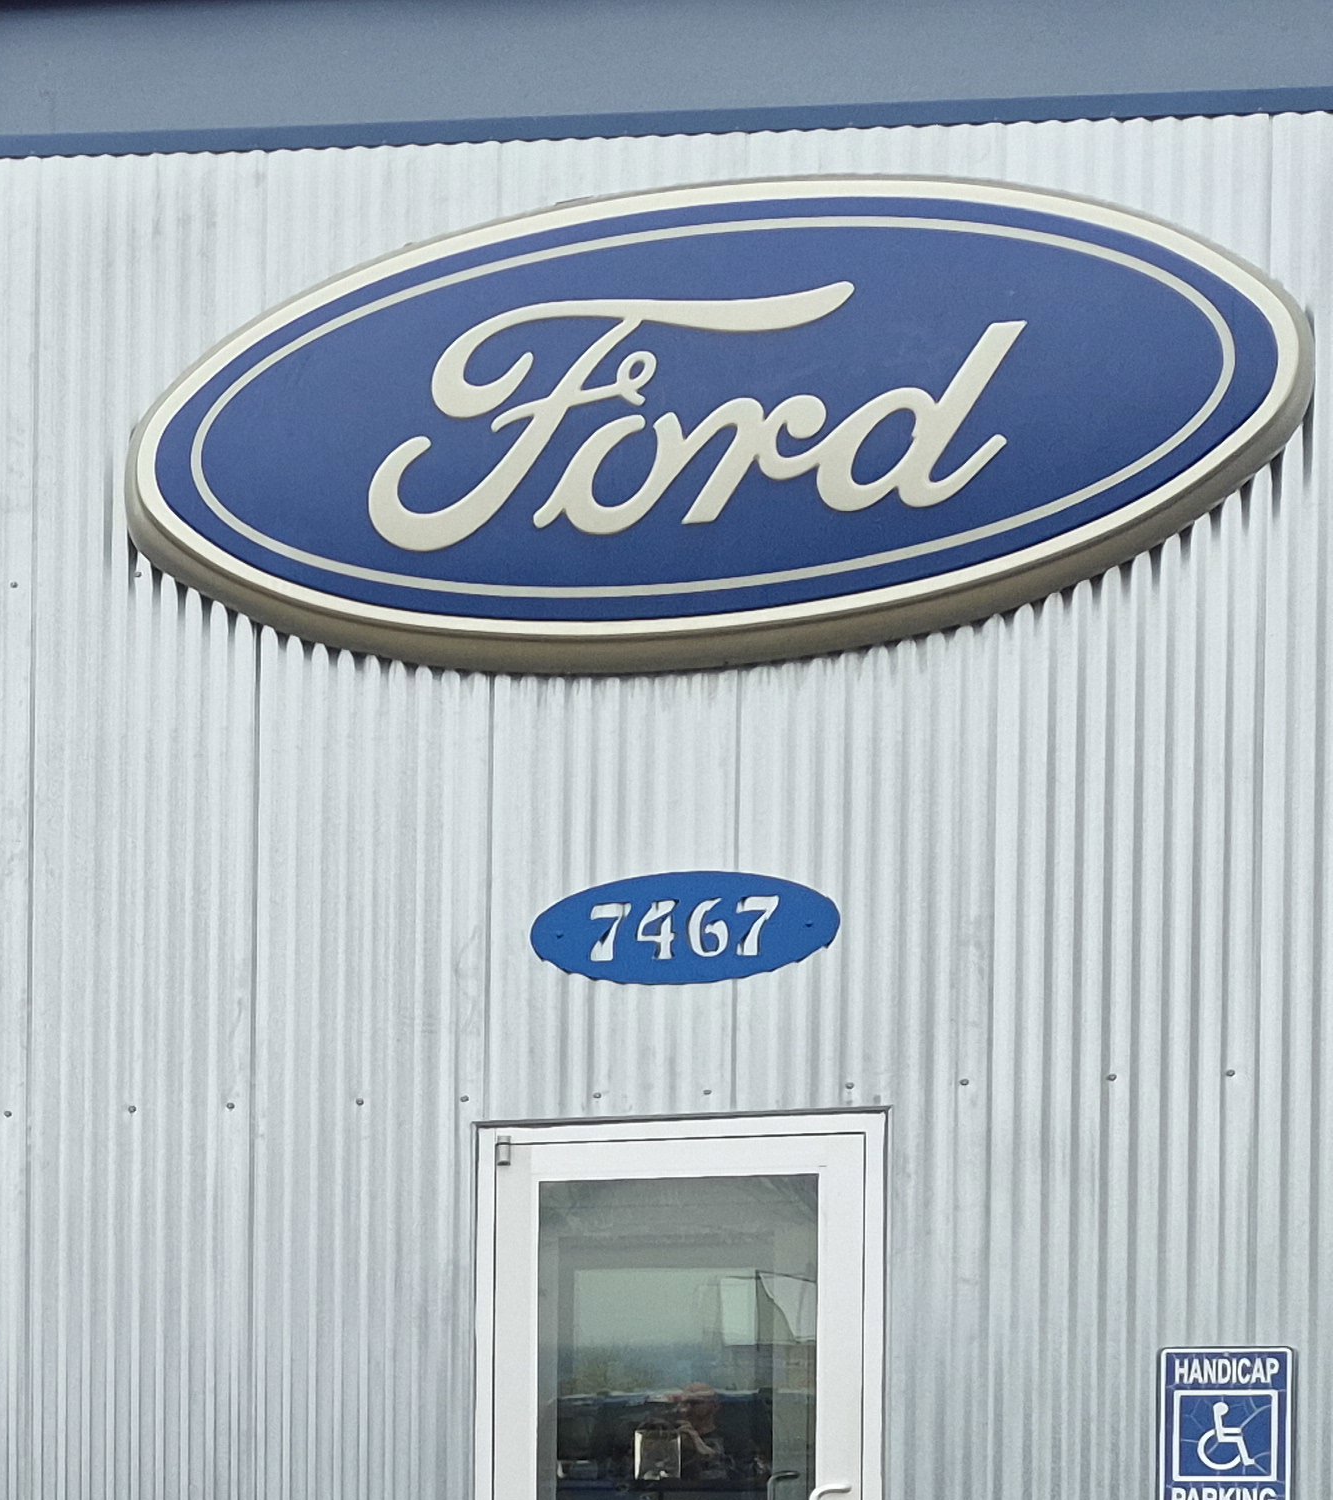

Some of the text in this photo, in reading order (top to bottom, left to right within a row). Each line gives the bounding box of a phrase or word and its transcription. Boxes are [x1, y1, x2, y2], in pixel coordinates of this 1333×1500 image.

[368, 280, 1027, 552] Ford
[590, 895, 780, 962] 7467
[1174, 1358, 1279, 1385] HANDICAP
